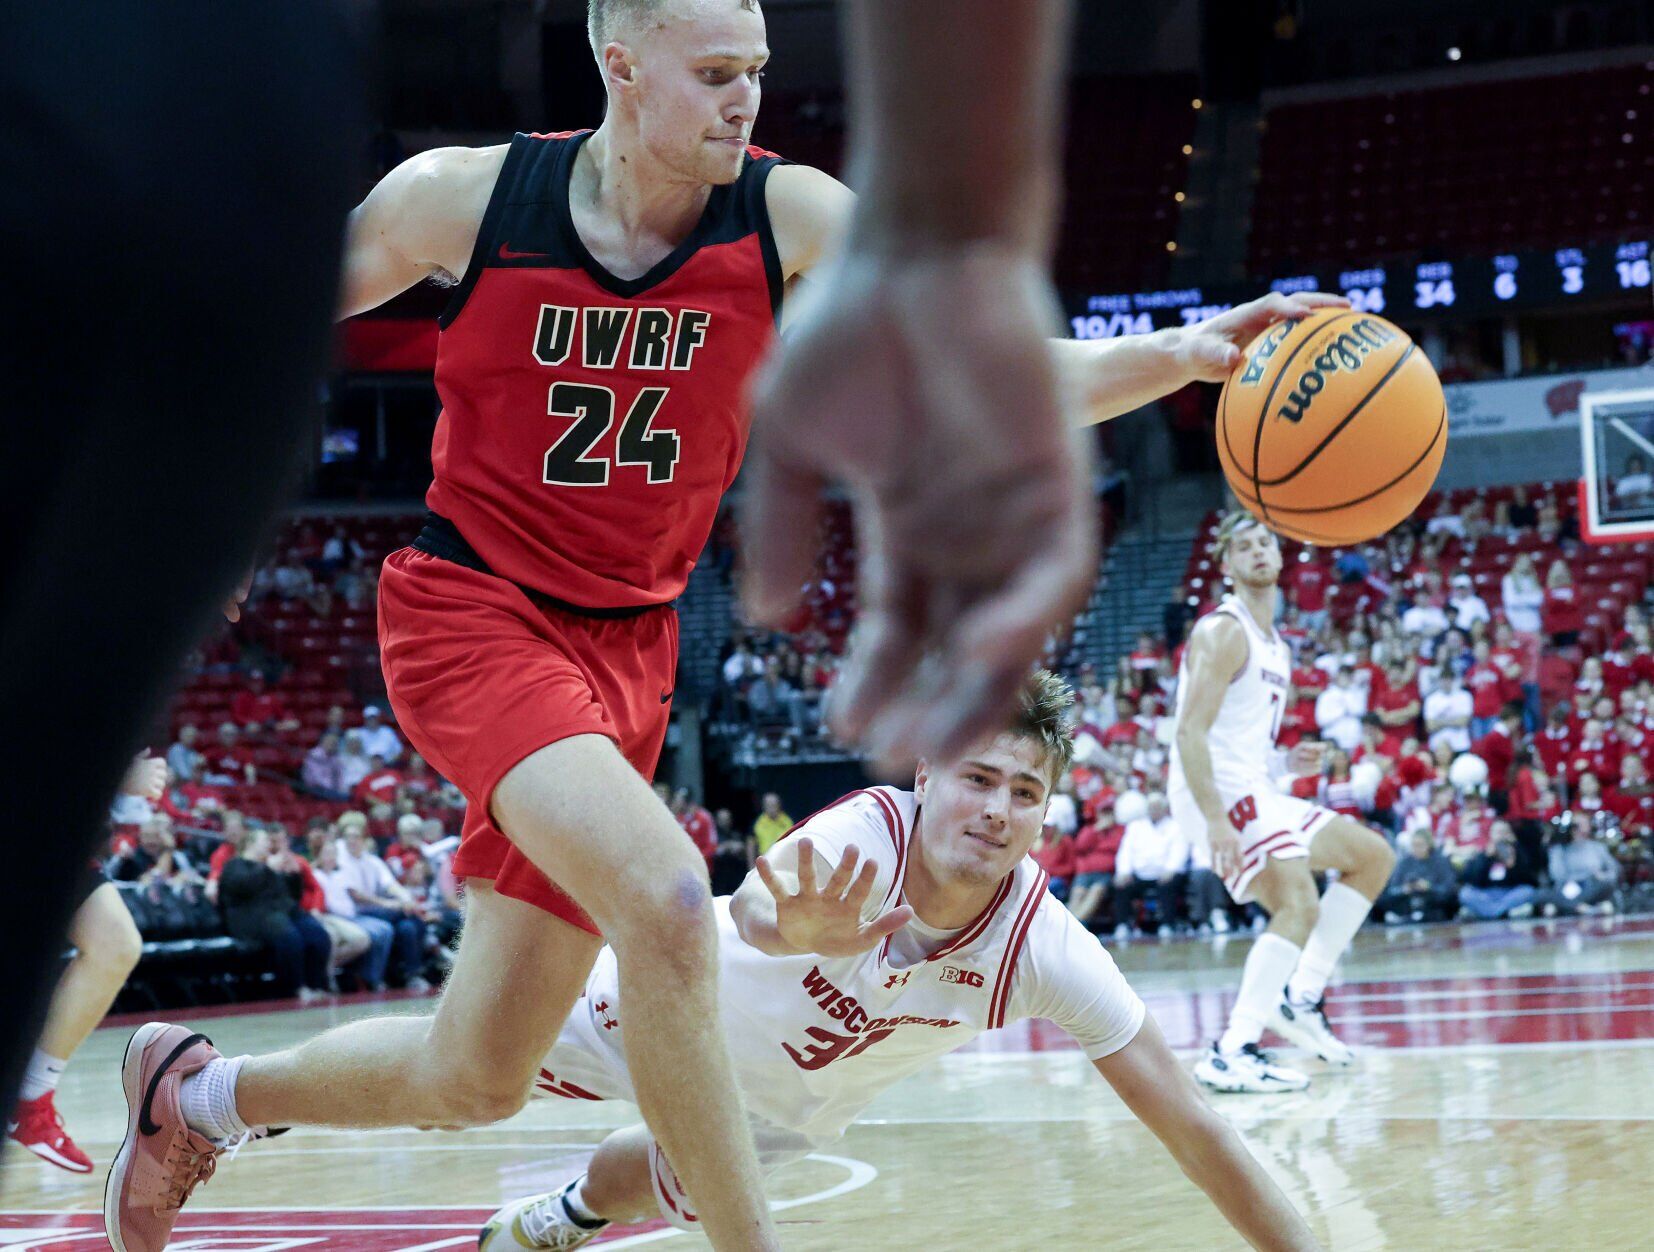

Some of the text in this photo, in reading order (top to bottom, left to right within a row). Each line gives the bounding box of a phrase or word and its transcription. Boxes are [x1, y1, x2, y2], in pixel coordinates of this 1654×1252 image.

[1494, 272, 1517, 300] 6
[1562, 266, 1584, 294] 3
[1616, 259, 1650, 288] 16
[1087, 288, 1202, 312] FREE THROWS
[1415, 280, 1455, 308] 34
[532, 303, 711, 370] UWRF
[1071, 312, 1154, 339] 10/14
[1276, 319, 1396, 424] Wilson
[542, 381, 681, 487] 24
[802, 965, 960, 1034] WISCONSIN
